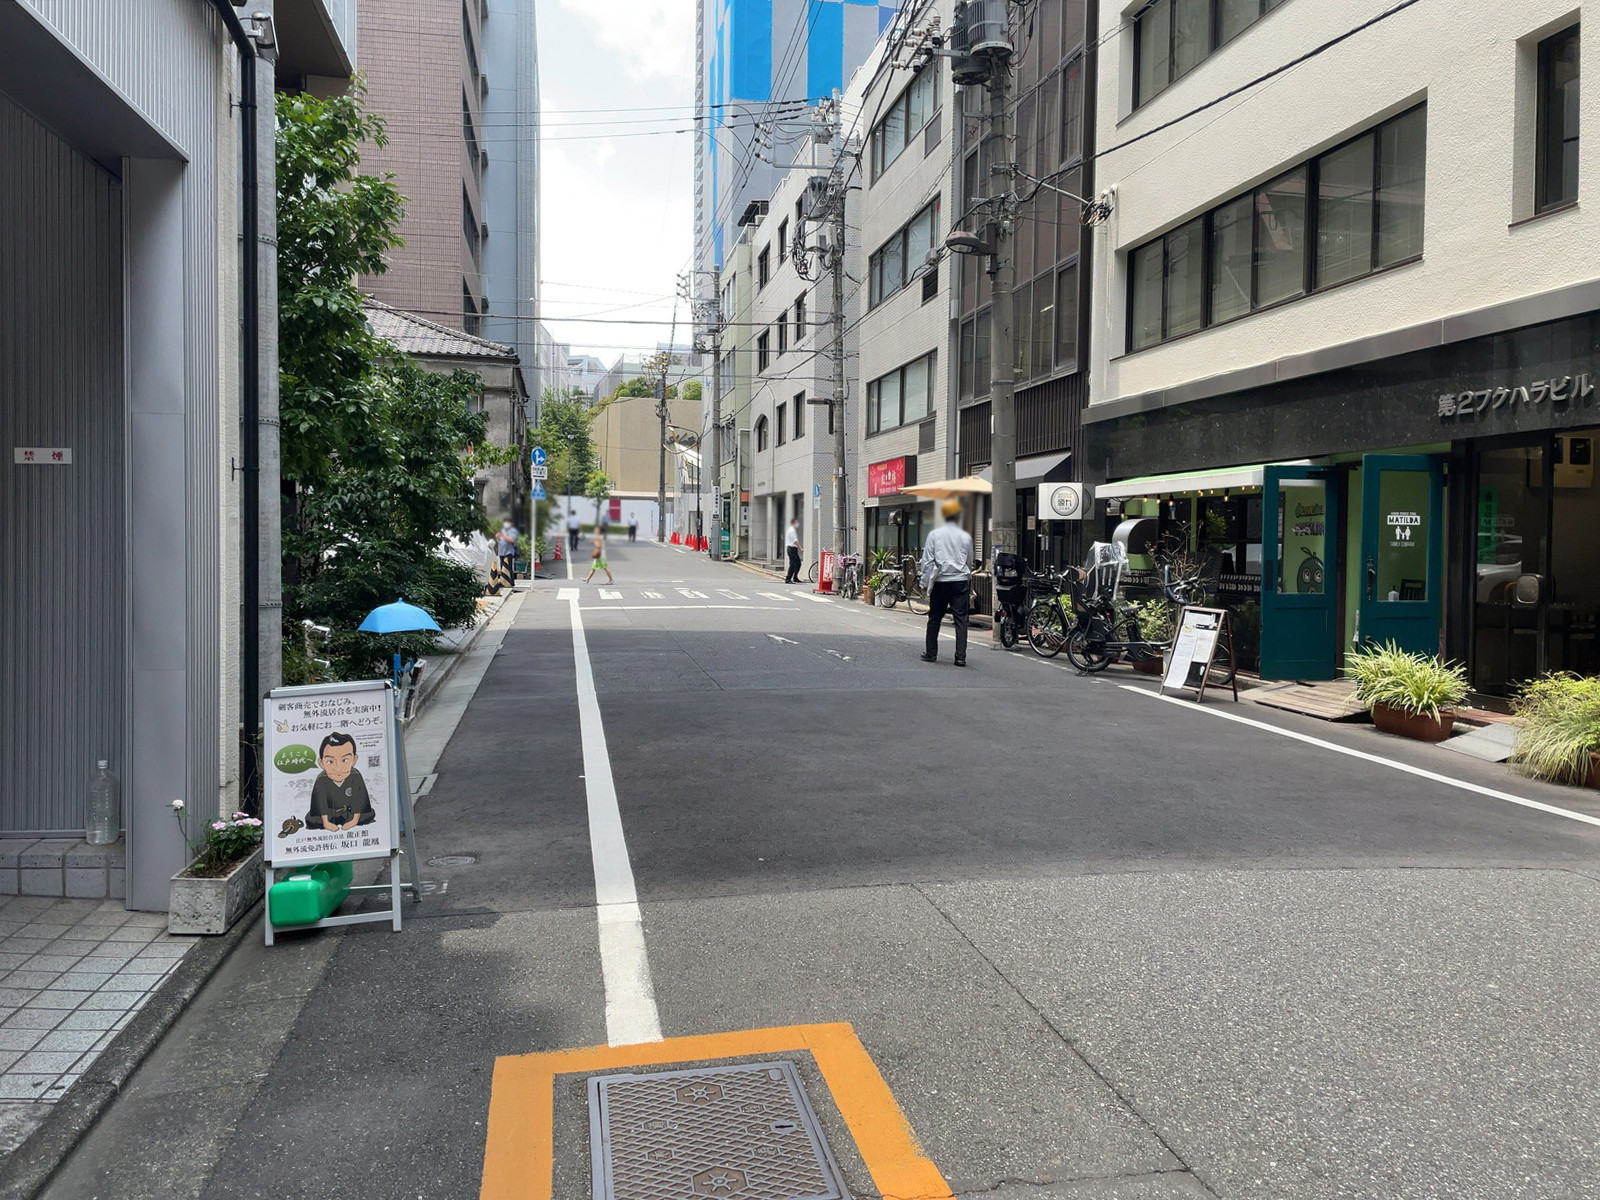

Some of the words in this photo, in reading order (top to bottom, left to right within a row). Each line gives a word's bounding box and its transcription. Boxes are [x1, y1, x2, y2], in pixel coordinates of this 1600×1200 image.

[1438, 373, 1594, 417] 第2フクハラビル
[1388, 516, 1419, 524] MATILDA
[278, 698, 355, 711] 剣客商売でおなじみ、
[341, 840, 358, 849] 坂口
